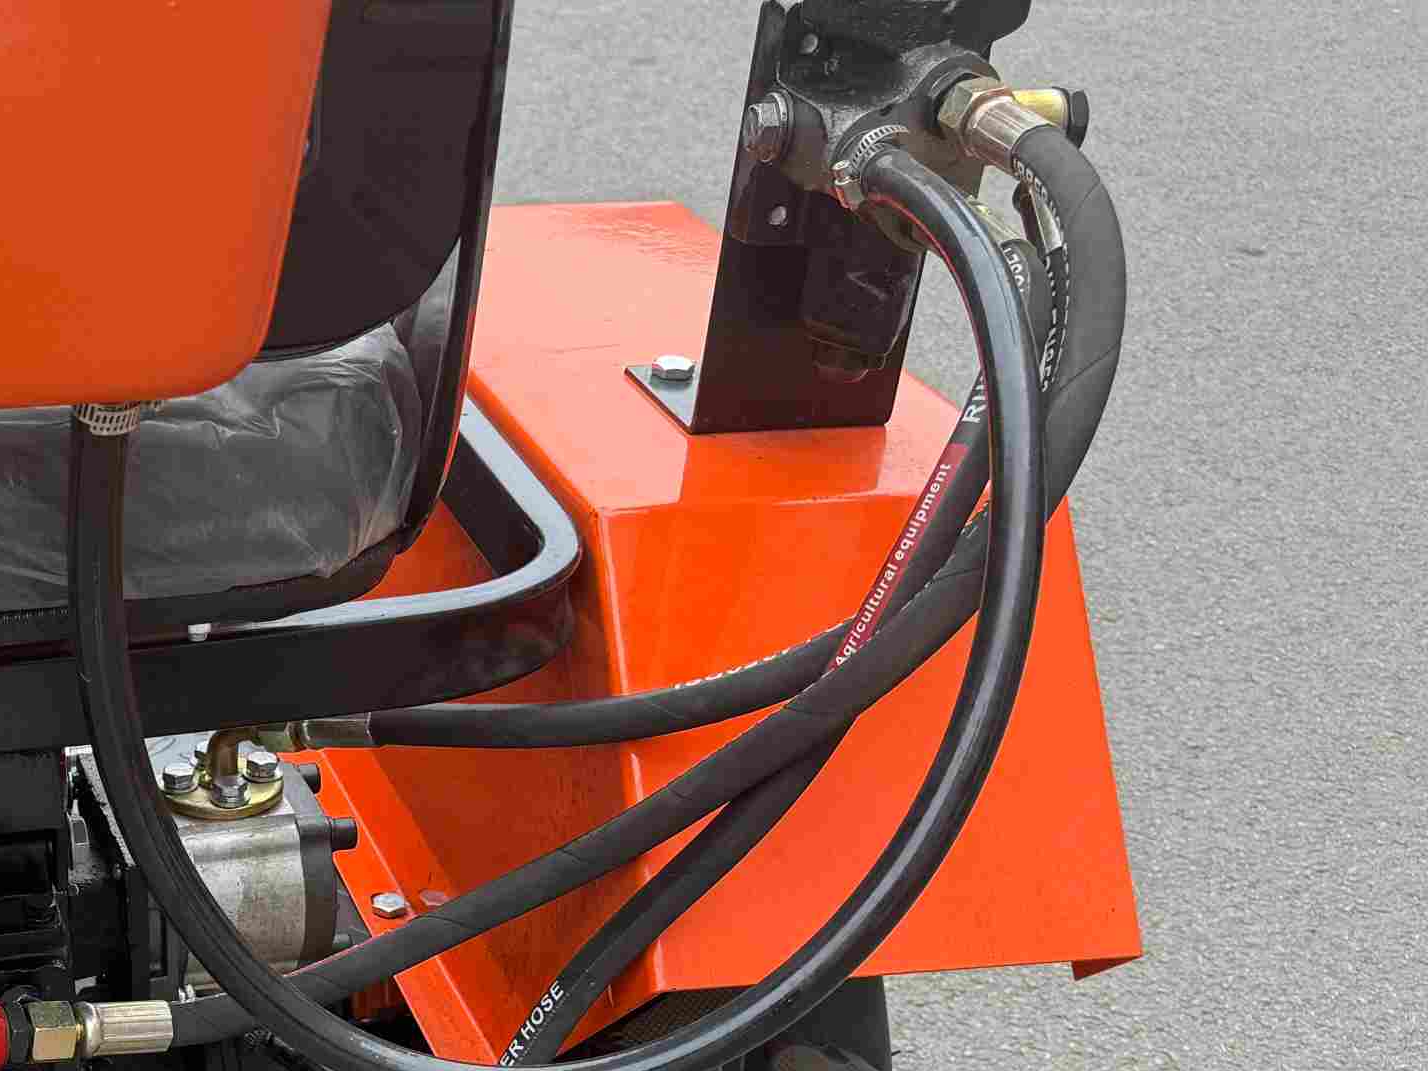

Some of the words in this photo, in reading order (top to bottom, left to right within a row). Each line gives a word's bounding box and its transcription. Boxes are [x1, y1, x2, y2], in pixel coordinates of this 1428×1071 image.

[834, 563, 899, 666] Agricultural
[895, 462, 952, 561] equipment
[521, 980, 564, 1040] HOSE
